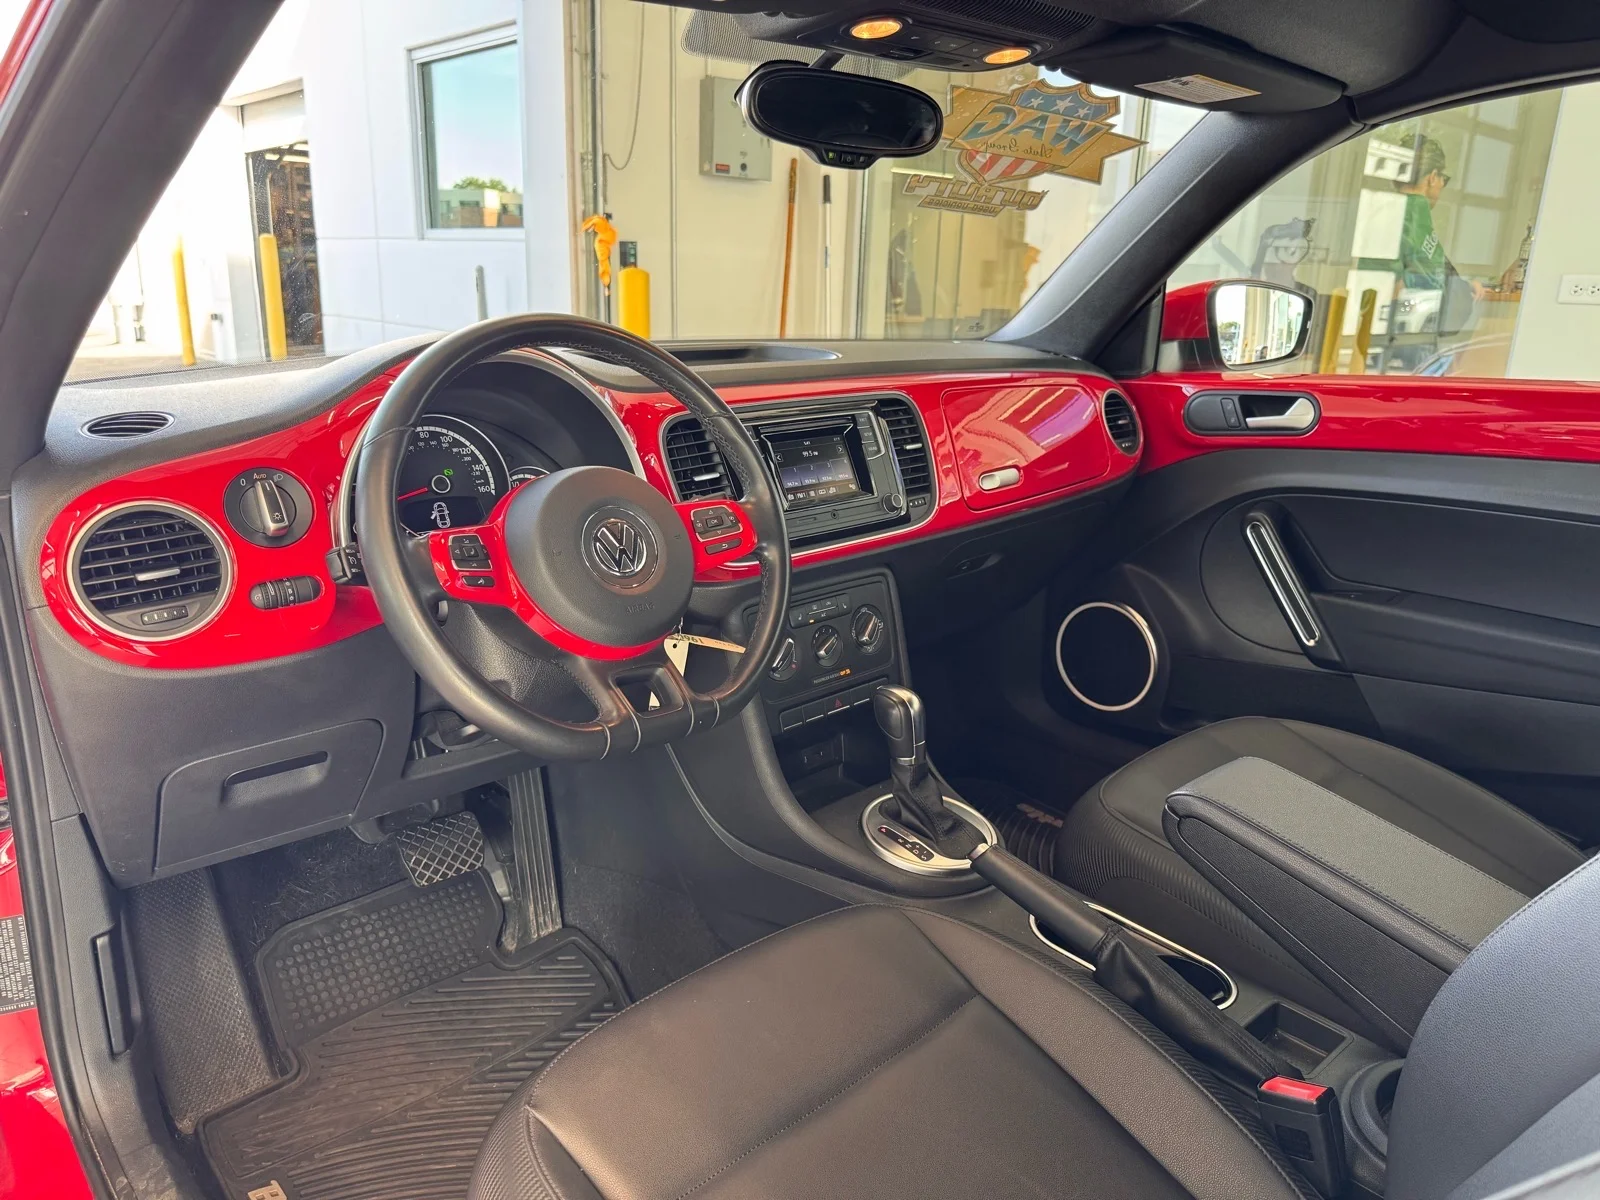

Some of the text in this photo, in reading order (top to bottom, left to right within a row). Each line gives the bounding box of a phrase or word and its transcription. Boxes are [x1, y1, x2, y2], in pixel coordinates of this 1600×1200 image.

[419, 431, 430, 439] 80
[439, 435, 453, 443] 100
[471, 463, 485, 471] 140
[477, 485, 491, 493] 160
